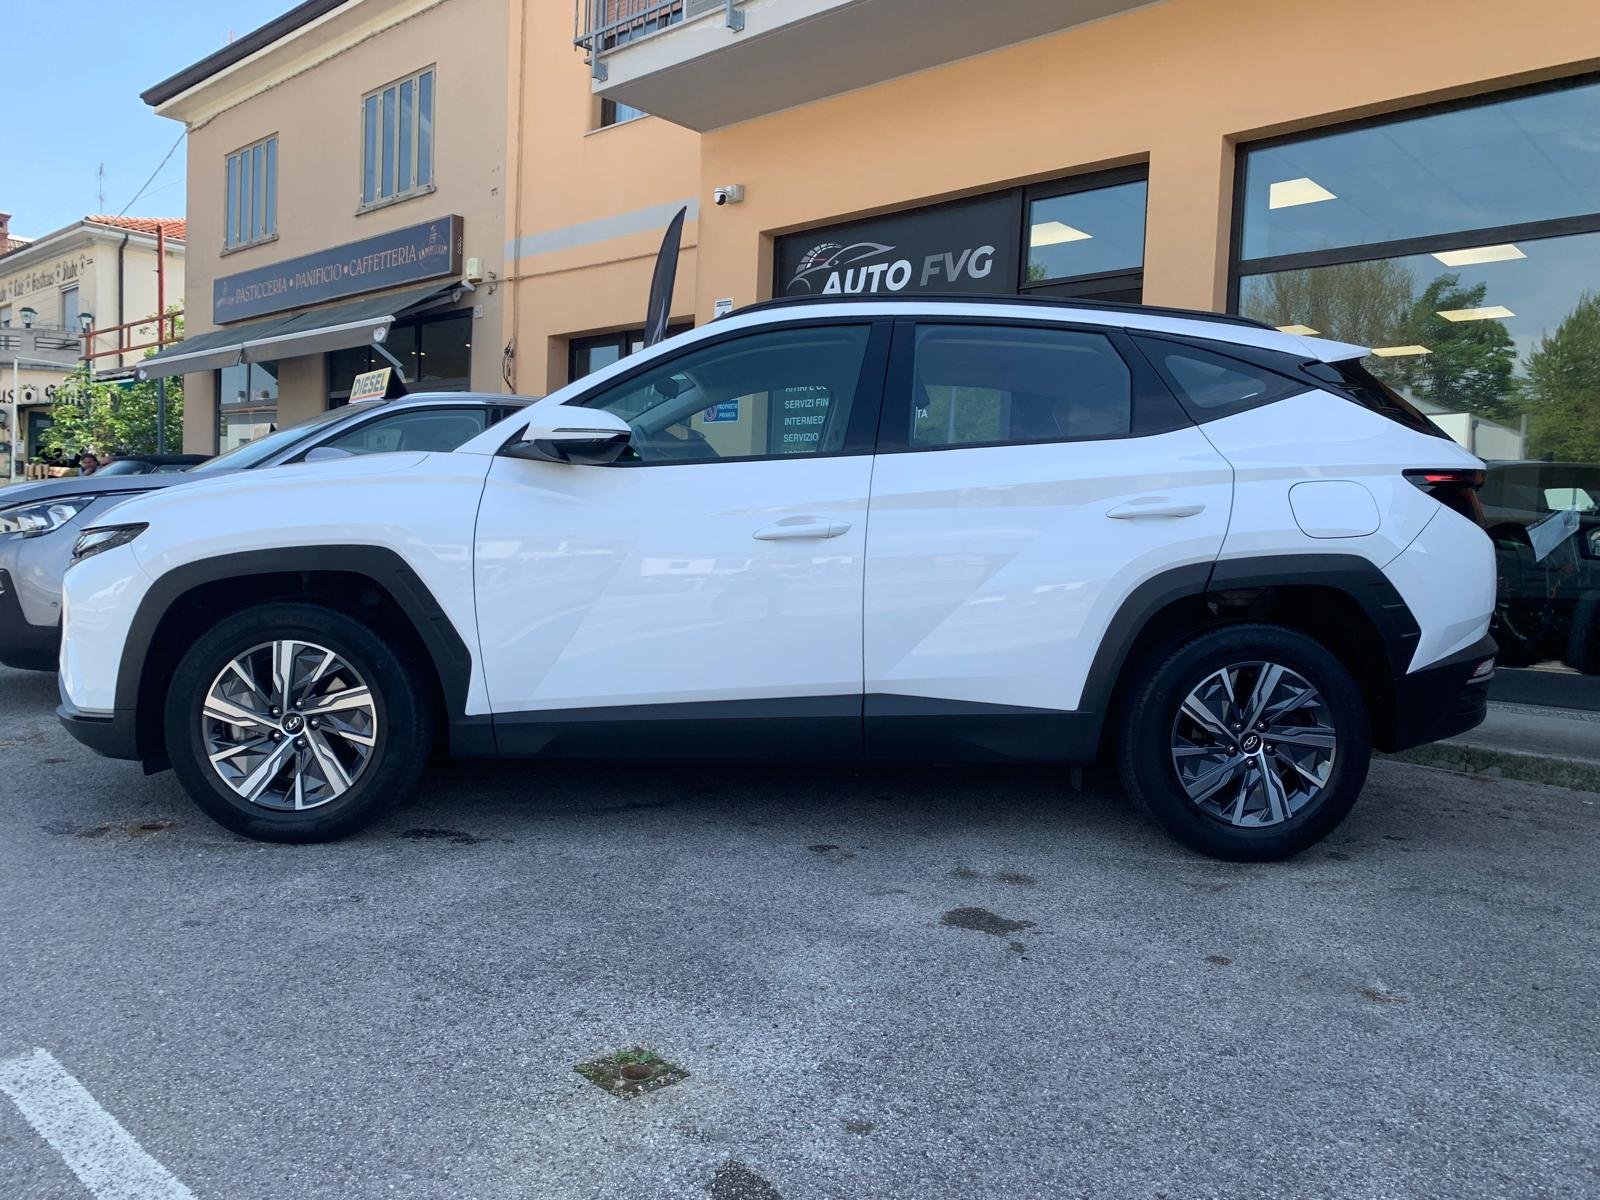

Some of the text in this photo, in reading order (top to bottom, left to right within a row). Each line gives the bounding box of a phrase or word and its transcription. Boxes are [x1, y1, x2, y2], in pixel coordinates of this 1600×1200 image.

[235, 277, 288, 304] PASTICCERIA
[295, 263, 342, 290] PANIFICIO
[349, 244, 417, 277] CAFFETTERIA
[822, 245, 996, 295] AUTO FVG
[351, 372, 385, 397] DIESEL
[784, 398, 829, 409] SERVIZI FIN
[783, 432, 819, 443] SERVIZIO
